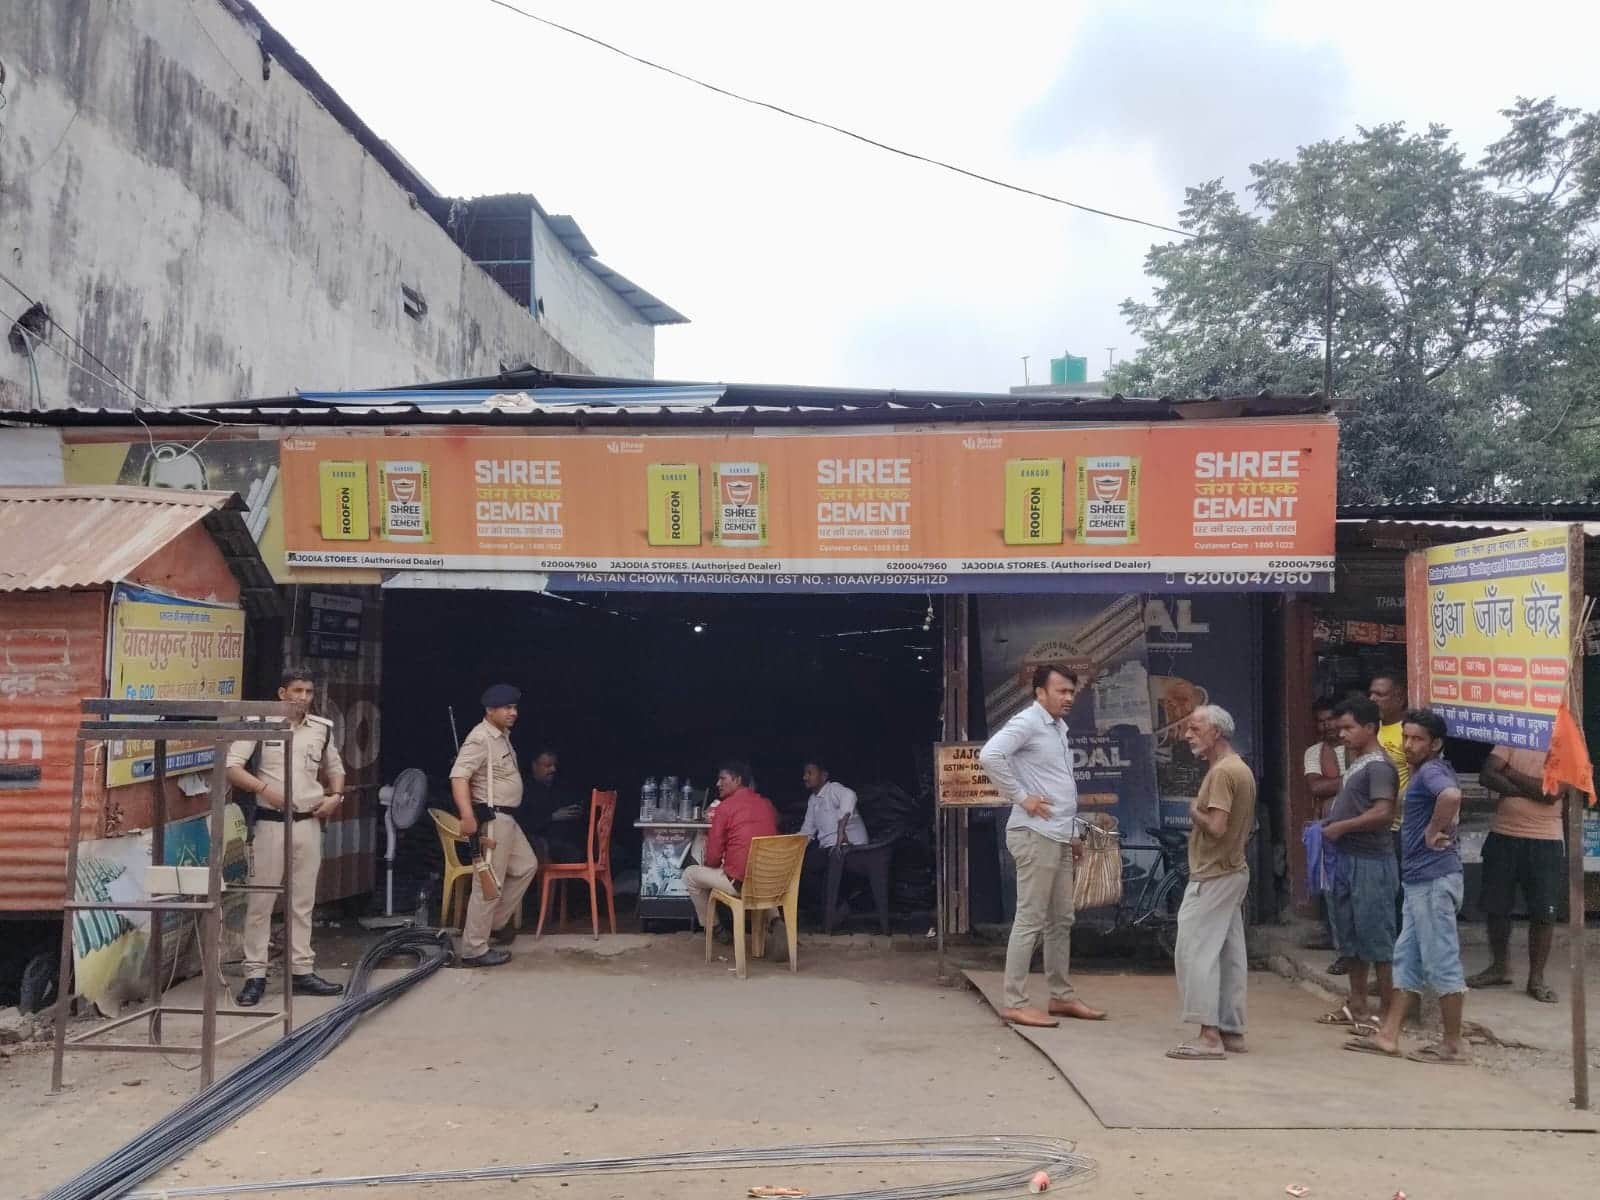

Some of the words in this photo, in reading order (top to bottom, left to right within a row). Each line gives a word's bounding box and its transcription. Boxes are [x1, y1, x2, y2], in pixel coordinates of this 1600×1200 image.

[1195, 451, 1300, 478] SHREE
[475, 460, 561, 484] SHREE
[817, 458, 911, 484] SHREE
[343, 487, 351, 534] ROOFON
[391, 505, 420, 514] SHREE
[476, 502, 562, 521] CEMENT
[725, 508, 756, 517] SHREE
[817, 502, 911, 522] CEMENT
[1030, 487, 1041, 538] ROOFON
[1090, 504, 1125, 514] SHREE
[1194, 497, 1298, 519] CEMENT
[671, 490, 680, 539] ROOFON
[391, 519, 420, 528] CEMENT
[725, 523, 756, 531] CEMENT
[1089, 519, 1125, 528] CEMENT
[413, 557, 444, 566] Dealer)
[610, 561, 649, 570] JAJODIA
[691, 562, 745, 572] (Authorised
[748, 562, 781, 571] Dealer)
[886, 562, 947, 570] 6200047960
[961, 562, 1004, 570] JAJODIA
[1051, 560, 1112, 570] (Authorised
[1114, 560, 1151, 570] Dealer)
[1268, 560, 1336, 568] 6200047960
[577, 573, 625, 583] MASTAN
[629, 573, 678, 584] CHOWK,
[681, 574, 765, 584] THARURGANJ
[775, 574, 798, 584] GST
[802, 575, 824, 584] NO.
[1184, 572, 1313, 585] 6200047960
[1433, 590, 1466, 648] धुँआ
[1473, 584, 1514, 637] जाँच
[1524, 577, 1563, 637] केंद्र
